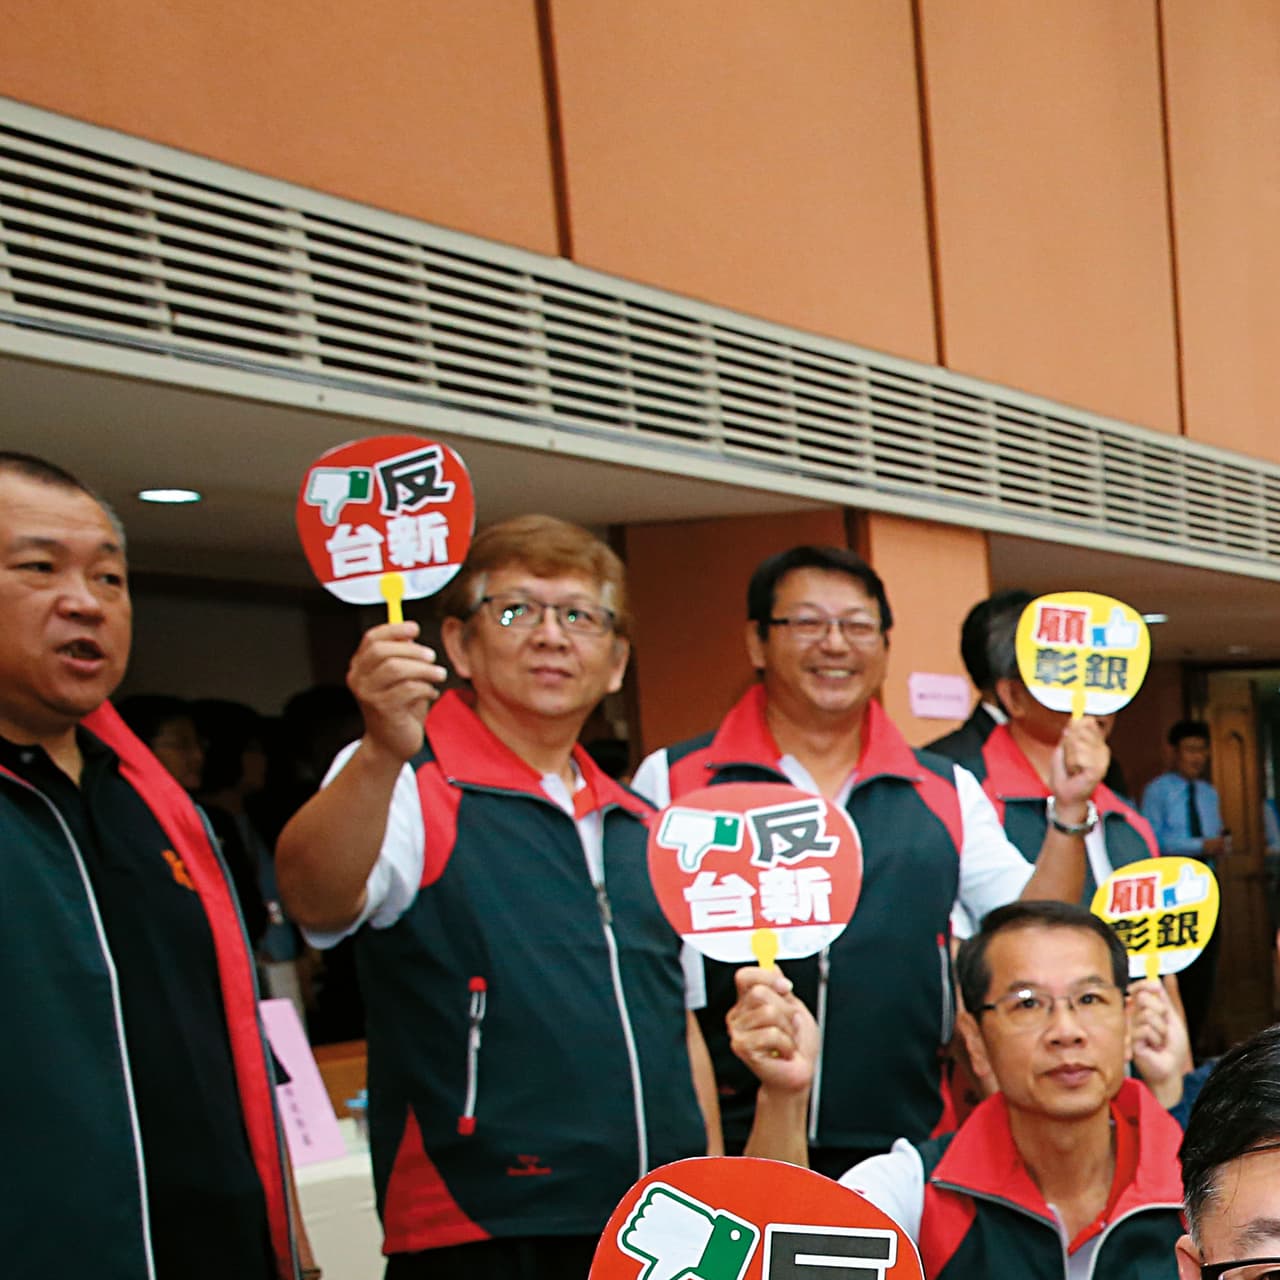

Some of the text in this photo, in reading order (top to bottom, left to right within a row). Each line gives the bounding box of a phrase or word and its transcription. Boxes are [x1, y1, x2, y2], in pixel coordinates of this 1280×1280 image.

[378, 449, 454, 513] 反
[326, 513, 450, 577] 台新
[1036, 606, 1085, 645] 顧
[1034, 648, 1129, 692] 彰銀
[750, 803, 836, 866] 反
[683, 866, 832, 930] 台新
[1109, 876, 1158, 914] 顧
[1107, 910, 1200, 952] 彰銀
